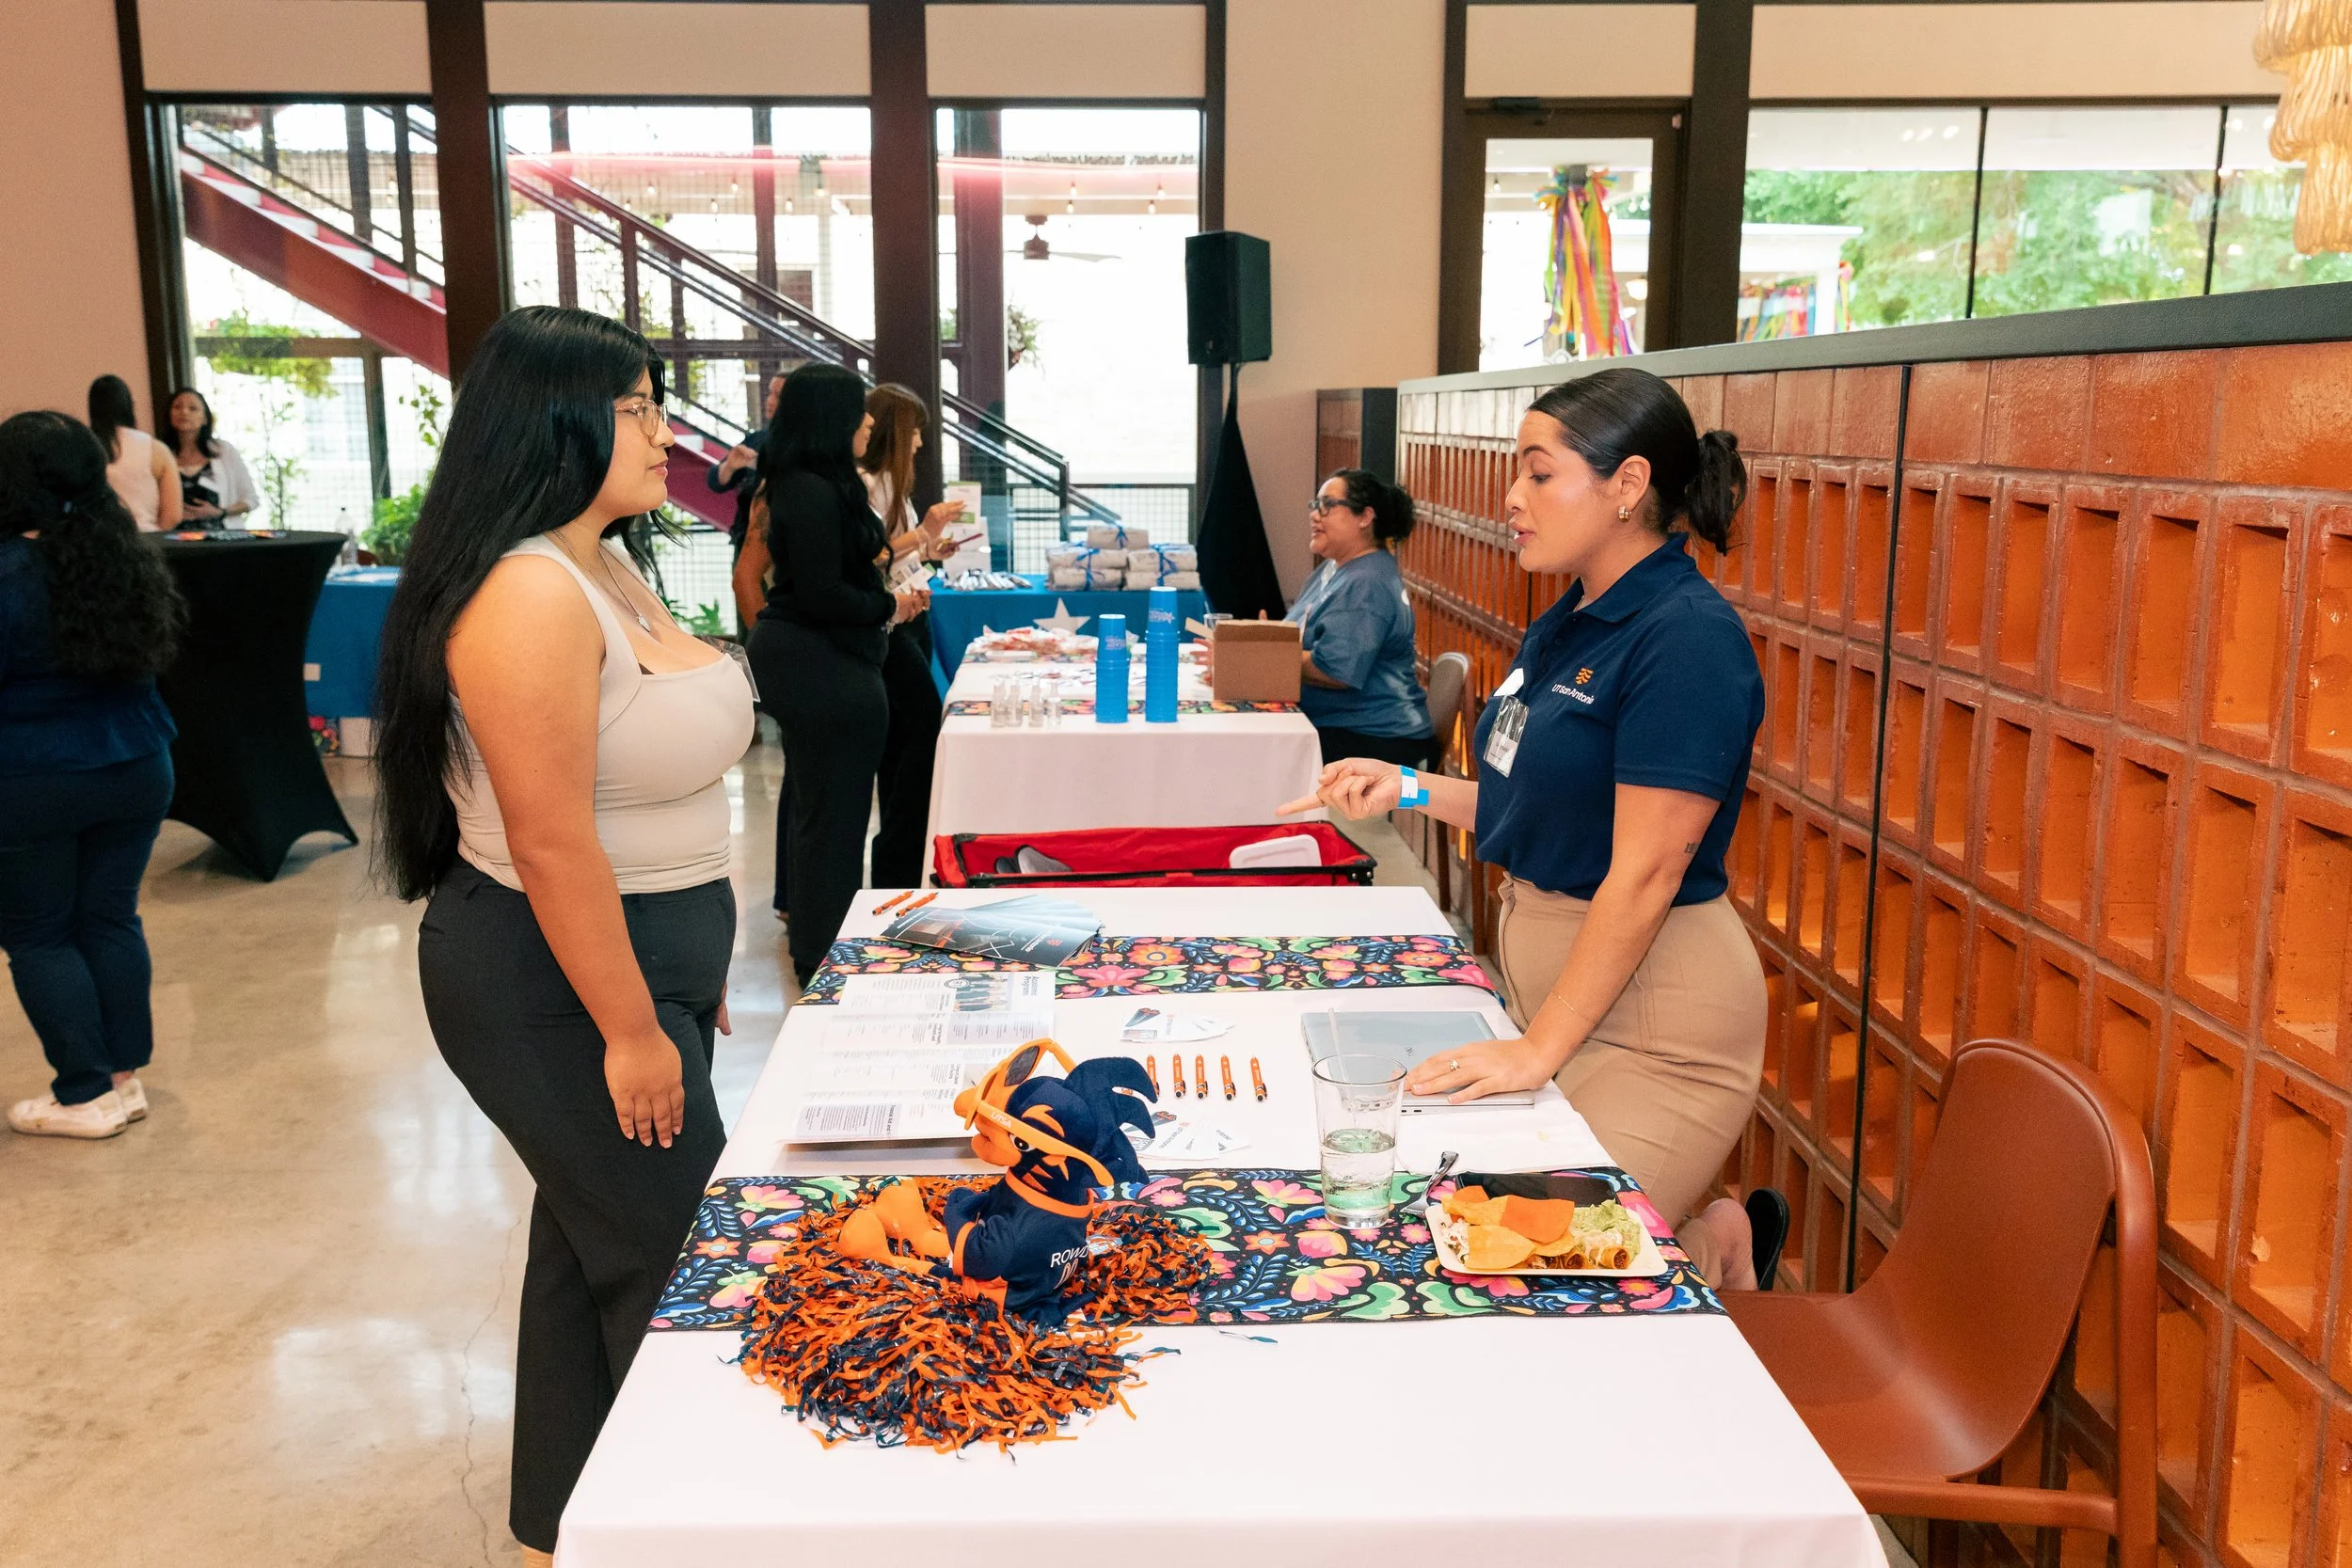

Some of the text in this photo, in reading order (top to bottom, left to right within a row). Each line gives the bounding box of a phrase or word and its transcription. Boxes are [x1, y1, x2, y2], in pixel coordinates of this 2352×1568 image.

[1551, 684, 1595, 705] UT San Antonio
[991, 1111, 1011, 1128] UTSA
